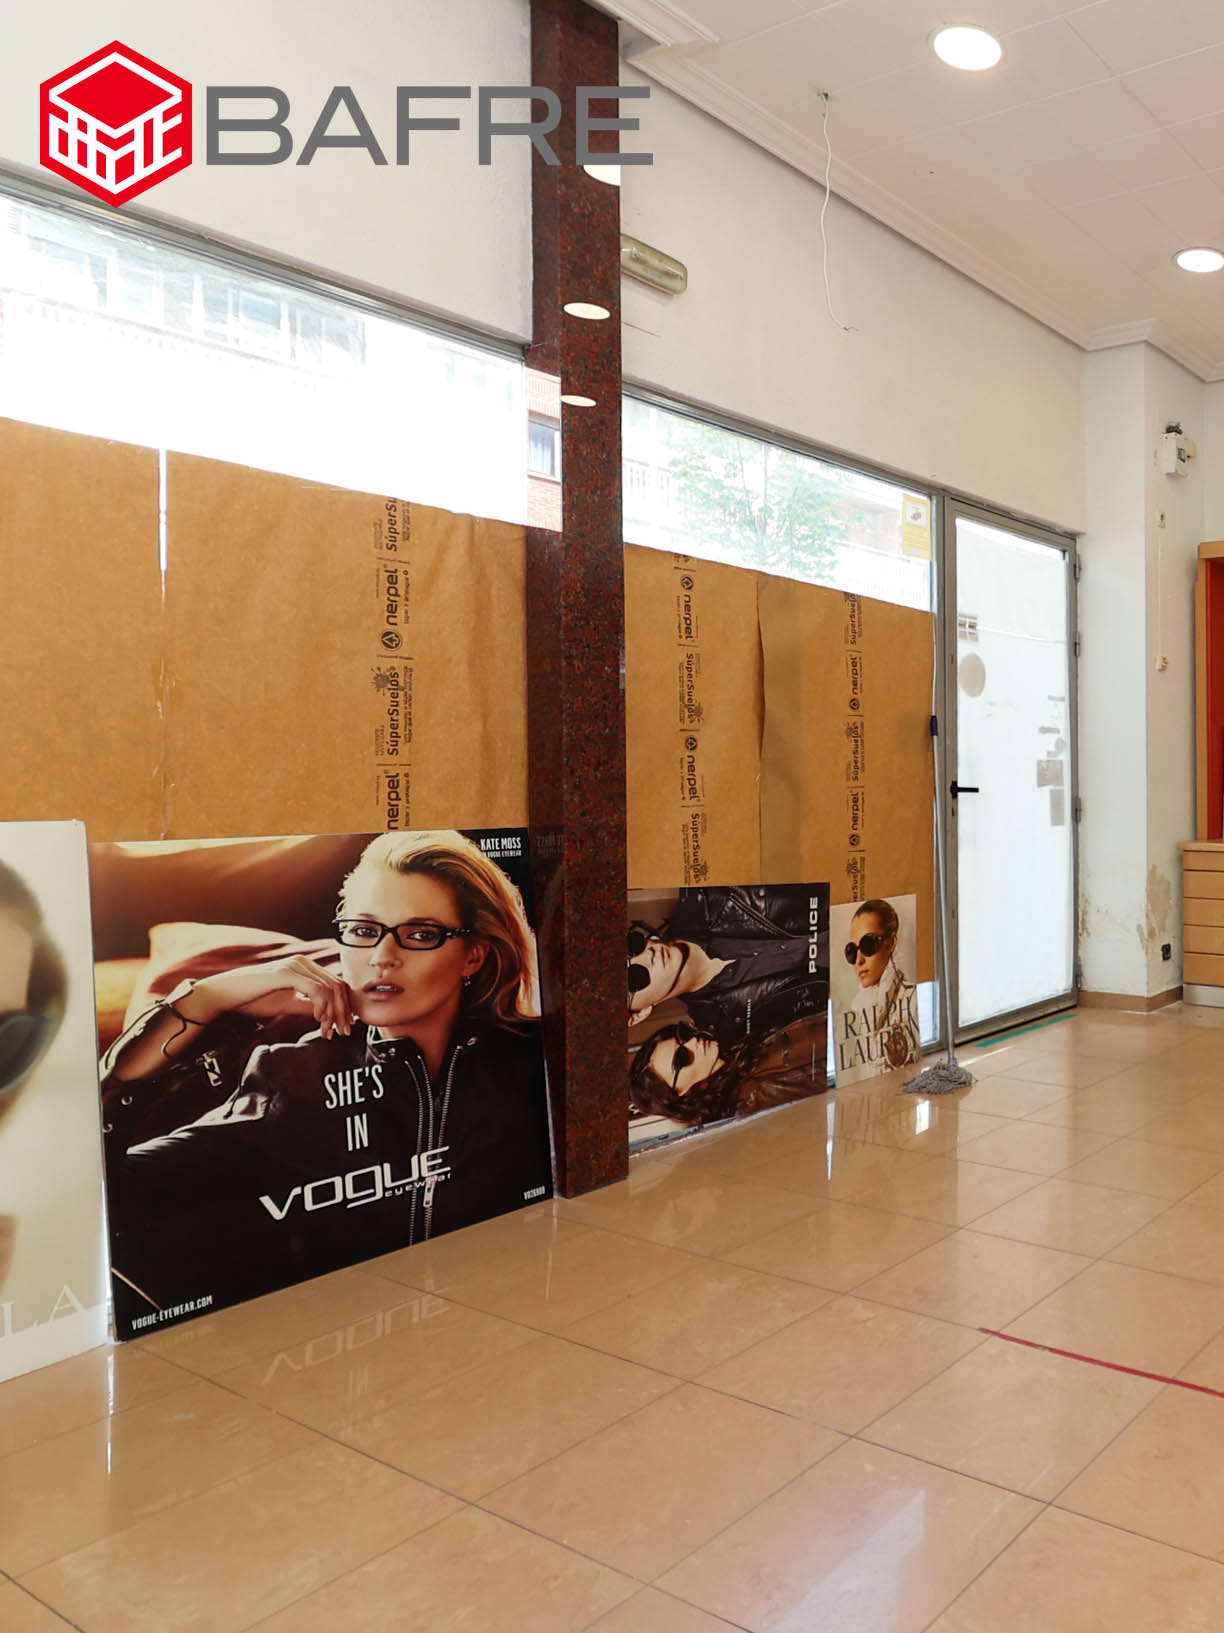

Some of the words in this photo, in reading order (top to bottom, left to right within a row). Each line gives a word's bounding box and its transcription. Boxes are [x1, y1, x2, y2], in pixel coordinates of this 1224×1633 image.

[384, 567, 401, 626] nerpel
[683, 594, 696, 640] nerpel
[850, 655, 859, 695] nerpel
[386, 671, 402, 757] SúperSuelos
[687, 755, 700, 801] nerpel
[385, 772, 401, 831] nerpel
[850, 791, 860, 831] nerpel
[480, 838, 500, 851] KATE
[501, 836, 521, 850] MOSS
[808, 896, 819, 974] POLICE
[324, 1064, 384, 1110] SHE'S
[346, 1113, 369, 1152] IN
[131, 1294, 214, 1331] VOGUE-EYEWEAR.COM
